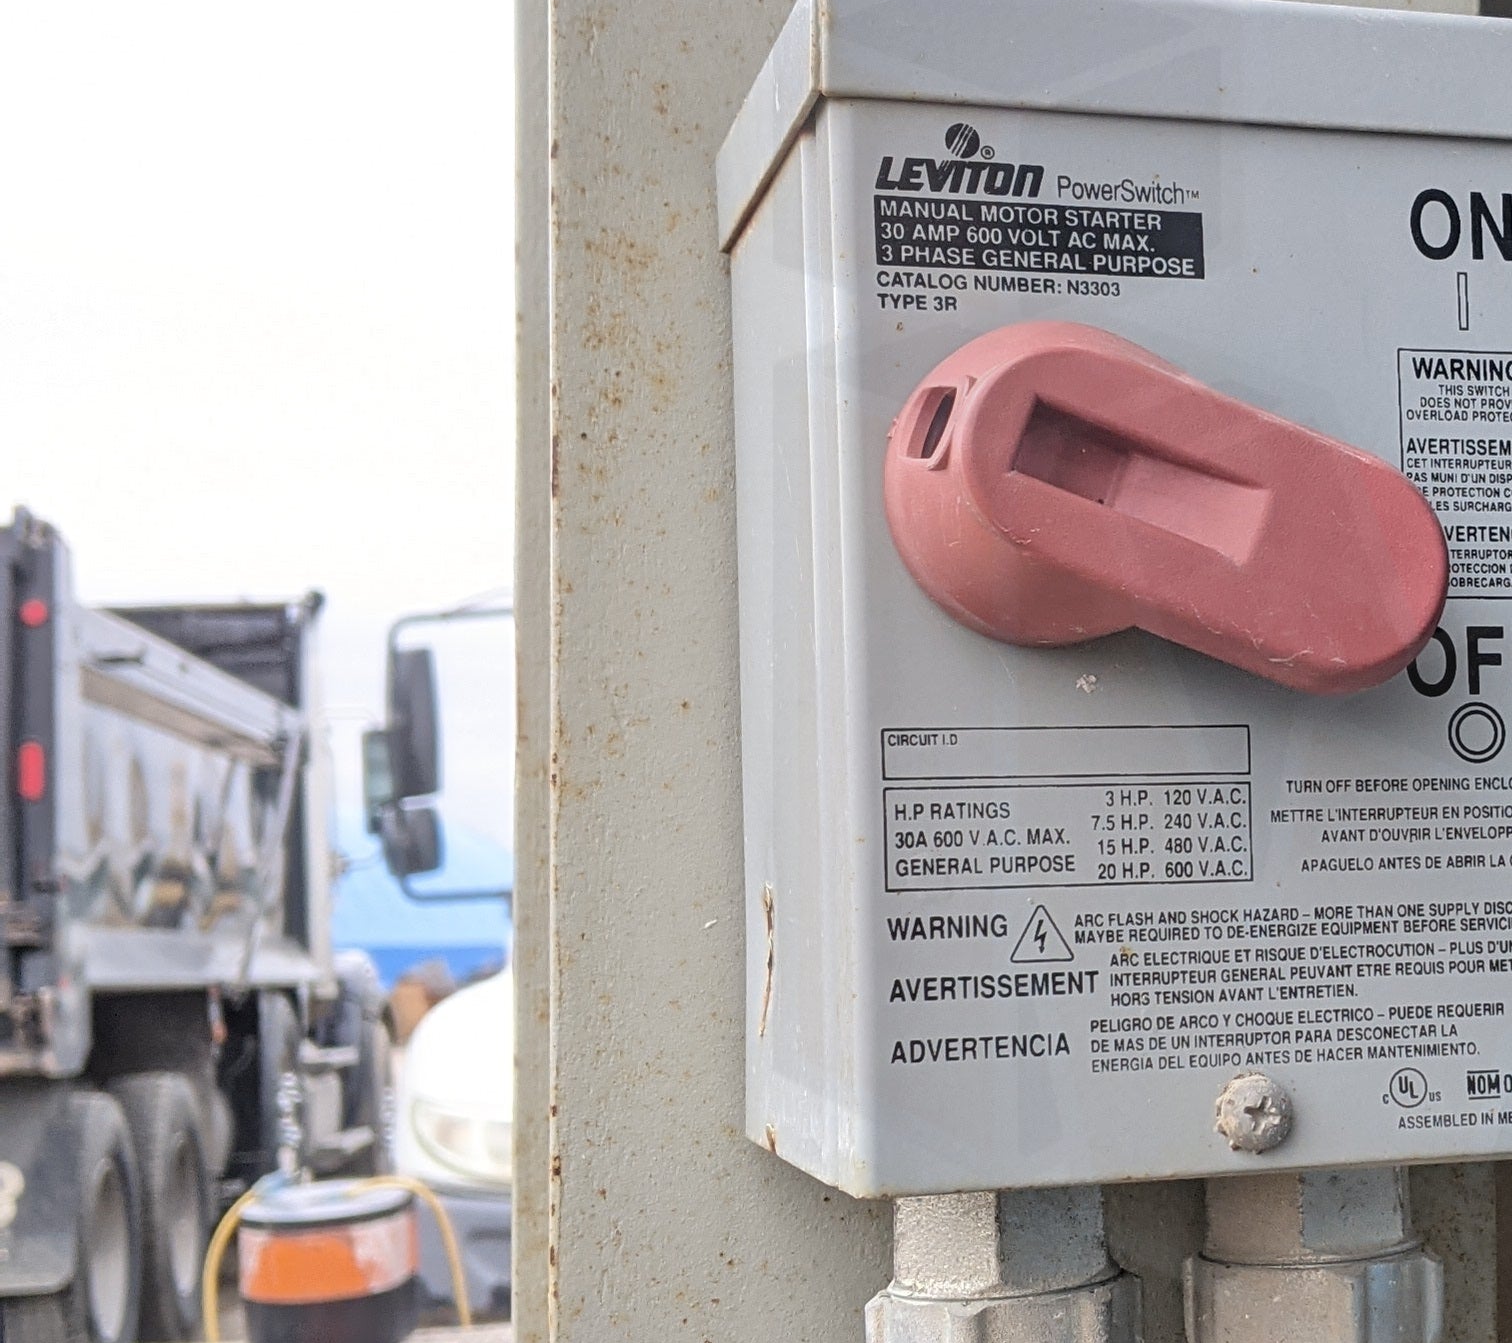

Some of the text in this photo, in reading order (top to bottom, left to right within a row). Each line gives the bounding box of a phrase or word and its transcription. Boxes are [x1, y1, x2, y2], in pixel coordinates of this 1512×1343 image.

[880, 200, 1162, 230] MANUAL MOTOR STARTER
[880, 222, 1155, 252] 30 AMP 600 VOLT AC MAX.
[881, 245, 1196, 276] 3 PHASE GENERAL PURPOSE
[876, 270, 1120, 297] CATALOG NUMBER: N3303
[876, 293, 958, 312] TYPE 3R
[1438, 384, 1510, 397] THIS SWITCH
[1420, 396, 1451, 411] DOES
[1454, 397, 1477, 412] NOT
[1406, 409, 1468, 422] OVERLOAD
[1406, 457, 1428, 469] CET
[1430, 458, 1512, 470] INTERRUPTEUR
[1430, 472, 1458, 483] MUNI
[1460, 473, 1486, 484] D'UN
[1432, 486, 1501, 498] PROTECTION
[1452, 562, 1506, 574] OTECCION
[887, 733, 939, 747] CIRCUIT
[1286, 780, 1322, 794] TURN
[1325, 779, 1352, 794] OFF
[1355, 778, 1408, 793] BEFORE
[1412, 777, 1470, 792] OPENING
[1105, 787, 1246, 807] 3 H.P. 120 V.A.C.
[930, 802, 1010, 820] RATINGS
[1091, 811, 1247, 831] 7.5 H.P. 240 V.A.C.
[1270, 808, 1324, 823] METTRE
[1327, 806, 1438, 822] L'INTERRUPTEUR
[1442, 806, 1460, 820] EN
[894, 827, 1071, 849] 30A 600 V.A.C. MAX.
[1321, 829, 1366, 843] AVANT
[1369, 827, 1431, 843] D'OUVRIR
[1098, 835, 1248, 856] 15 H.P. 480 V.A.C.
[895, 854, 1076, 877] GENERAL PURPOSE
[1098, 859, 1248, 880] 20 H.P. 600 V.A.C.
[1301, 857, 1374, 872] APAGUELO
[1378, 856, 1422, 870] ANTES
[1424, 855, 1442, 869] DE
[1446, 854, 1486, 868] ABRIR
[1489, 854, 1506, 868] LA
[1074, 913, 1104, 928] ARC
[1108, 912, 1154, 927] FLASH
[1158, 911, 1187, 925] AND
[1190, 909, 1239, 924] SHOCK
[1243, 907, 1299, 922] HAZARD
[1314, 905, 1353, 920] MORE
[1356, 905, 1394, 918] THAN
[1396, 903, 1426, 918] ONE
[1428, 902, 1480, 917] SUPPLY
[886, 914, 1008, 940] WARNING
[1074, 929, 1124, 944] MAYBE
[1128, 926, 1200, 942] REQUIRED
[1204, 925, 1223, 940] TO
[1226, 923, 1318, 939] DE-ENERGIZE
[1321, 920, 1399, 936] EQUIPMENT
[1403, 918, 1457, 933] BEFORE
[1110, 950, 1140, 967] ARC
[1143, 949, 1230, 966] ELECTRIQUE
[1234, 948, 1252, 963] ET
[1255, 947, 1306, 962] RISQUE
[1309, 943, 1435, 960] D'ELECTROCUTION
[1449, 940, 1484, 955] PLUS
[1110, 969, 1217, 987] INTERRUPTEUR
[1220, 967, 1286, 983] GENERAL
[1290, 964, 1353, 980] PEUVANT
[1356, 963, 1392, 978] ETRE
[1395, 961, 1445, 976] REQUIS
[1448, 959, 1486, 974] POUR
[889, 971, 1100, 1002] AVERTISSEMENT
[1110, 983, 1358, 1007] HORS TENSION AVANT L'ENTRETIEN.
[890, 1033, 1070, 1063] ADVERTENCIA
[1091, 1042, 1480, 1073] ENERGIA DEL EQUIPO ANTES DE HACER MANTENIMIENTO.
[1398, 1113, 1478, 1129] ASSEMBLED
[1481, 1112, 1494, 1125] IN
